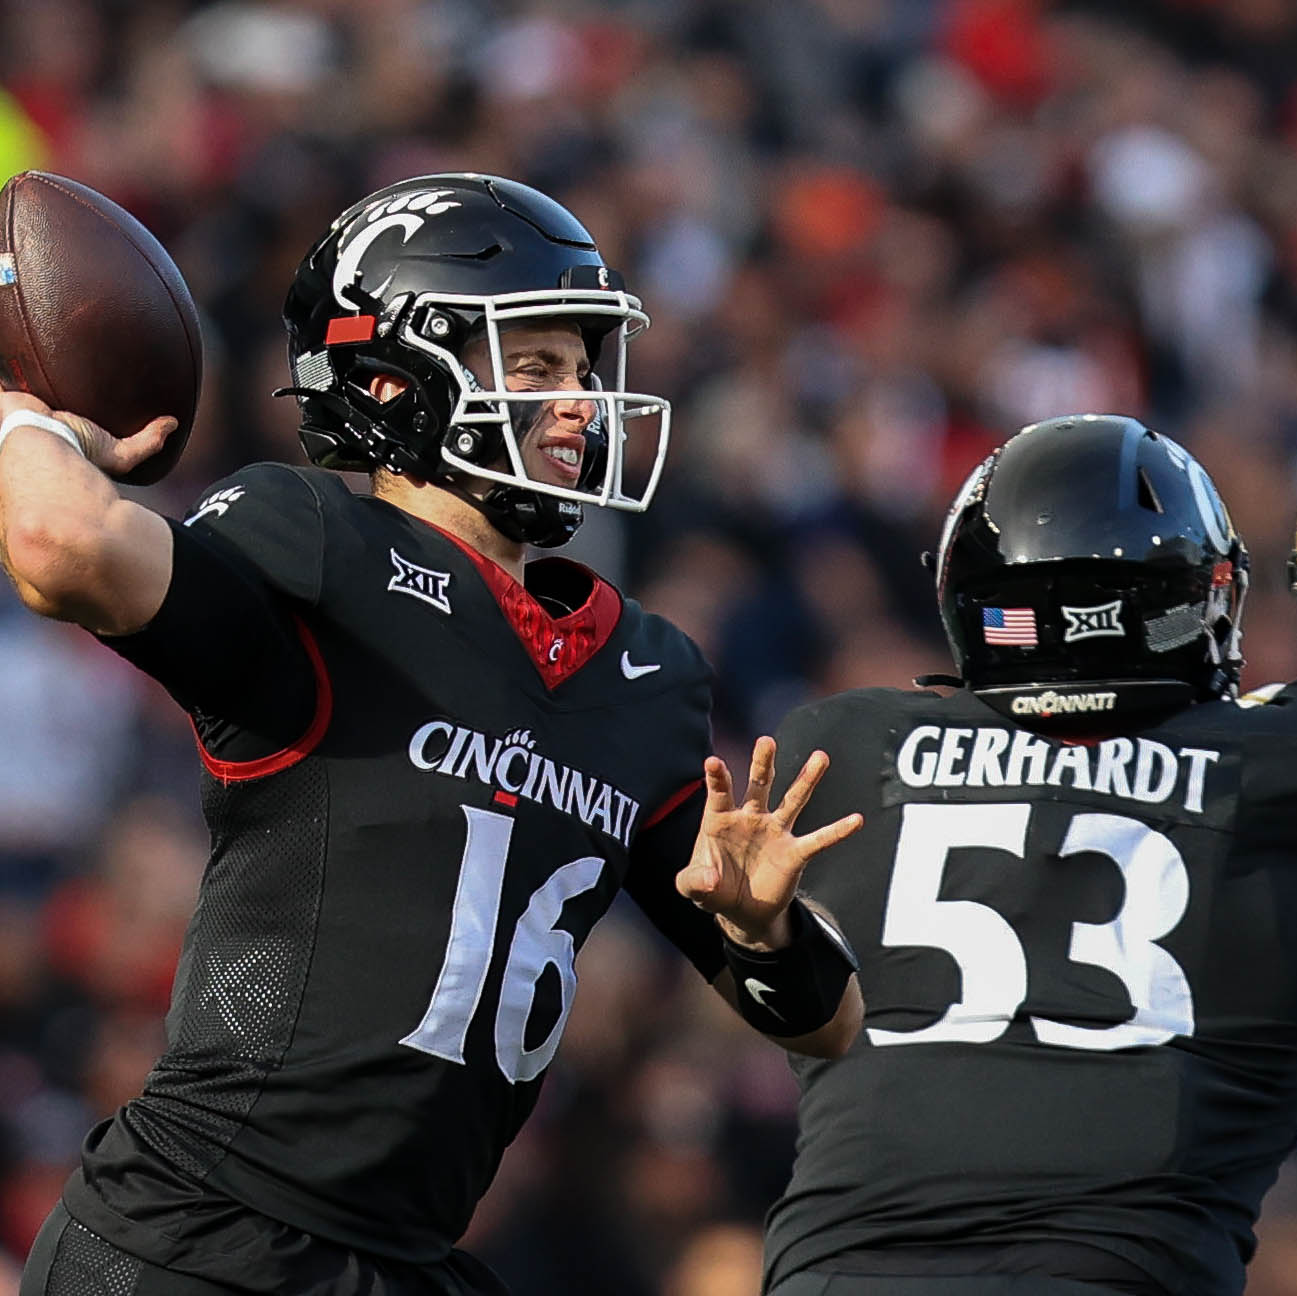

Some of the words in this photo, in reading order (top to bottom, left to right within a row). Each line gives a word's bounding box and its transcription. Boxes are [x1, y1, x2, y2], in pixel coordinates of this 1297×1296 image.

[1012, 691, 1117, 718] CINCINNATI
[409, 720, 640, 848] CINCINNATI
[898, 725, 1220, 814] GERHARDT
[399, 804, 606, 1085] 16
[866, 803, 1196, 1050] 53
